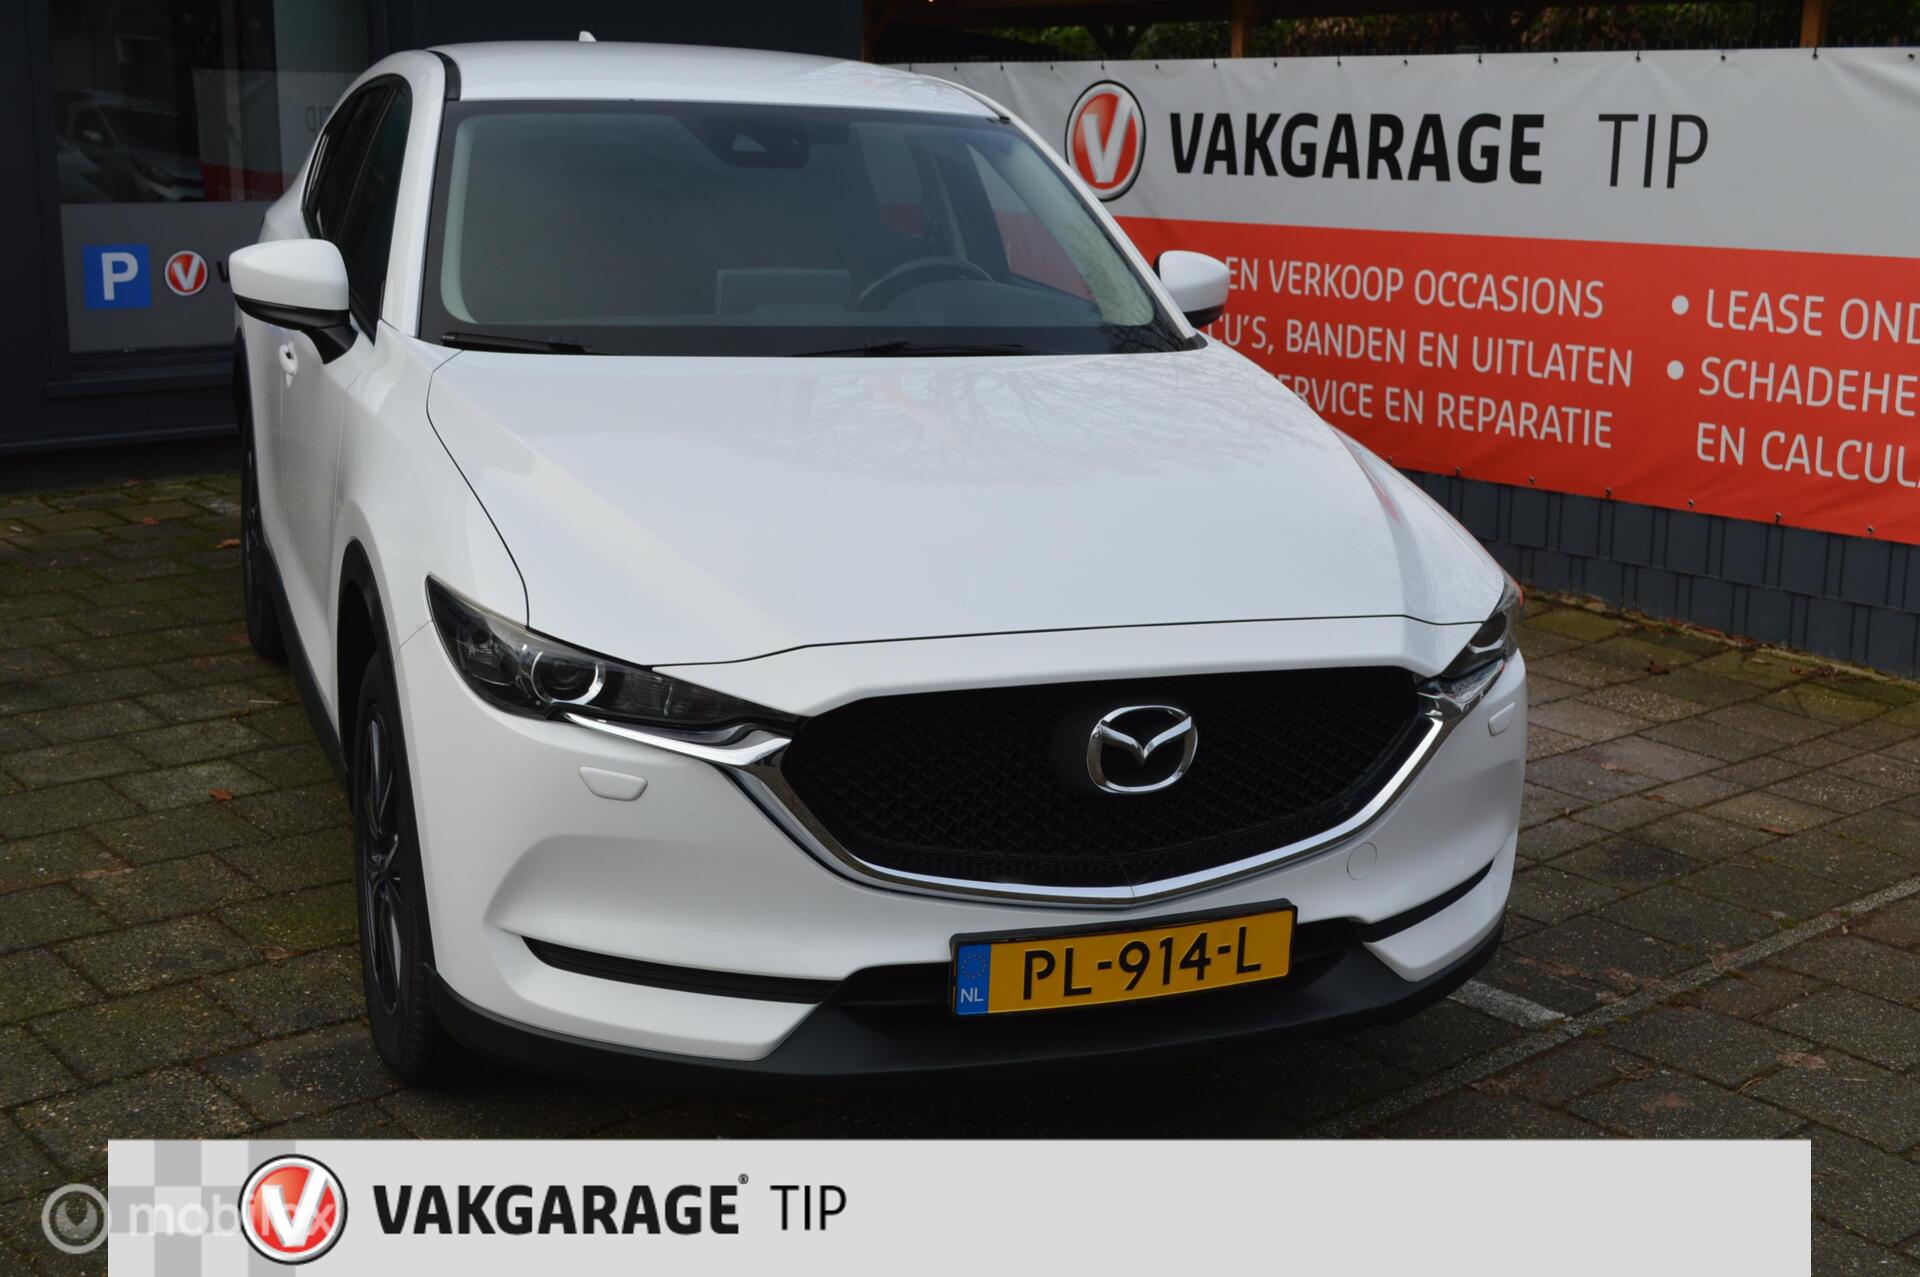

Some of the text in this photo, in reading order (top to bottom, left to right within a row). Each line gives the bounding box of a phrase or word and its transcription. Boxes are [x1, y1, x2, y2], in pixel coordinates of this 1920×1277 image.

[1169, 112, 1709, 189] VAKGARAGE TIP
[101, 252, 139, 301] P
[1268, 259, 1404, 303] VERKOOP
[1413, 269, 1605, 319] OCCASIONS
[1705, 288, 1825, 337] LEASE
[1285, 318, 1406, 365] BANDEN
[1418, 330, 1458, 370] EN
[1471, 335, 1633, 388] UITLATEN
[1273, 373, 1614, 449] RVICE EN REPARATIE
[1698, 357, 1918, 417] SCHADEHE
[1696, 422, 1920, 490] EN CALCUL
[960, 987, 984, 1003] NL
[1022, 926, 1262, 1001] PL-914-L
